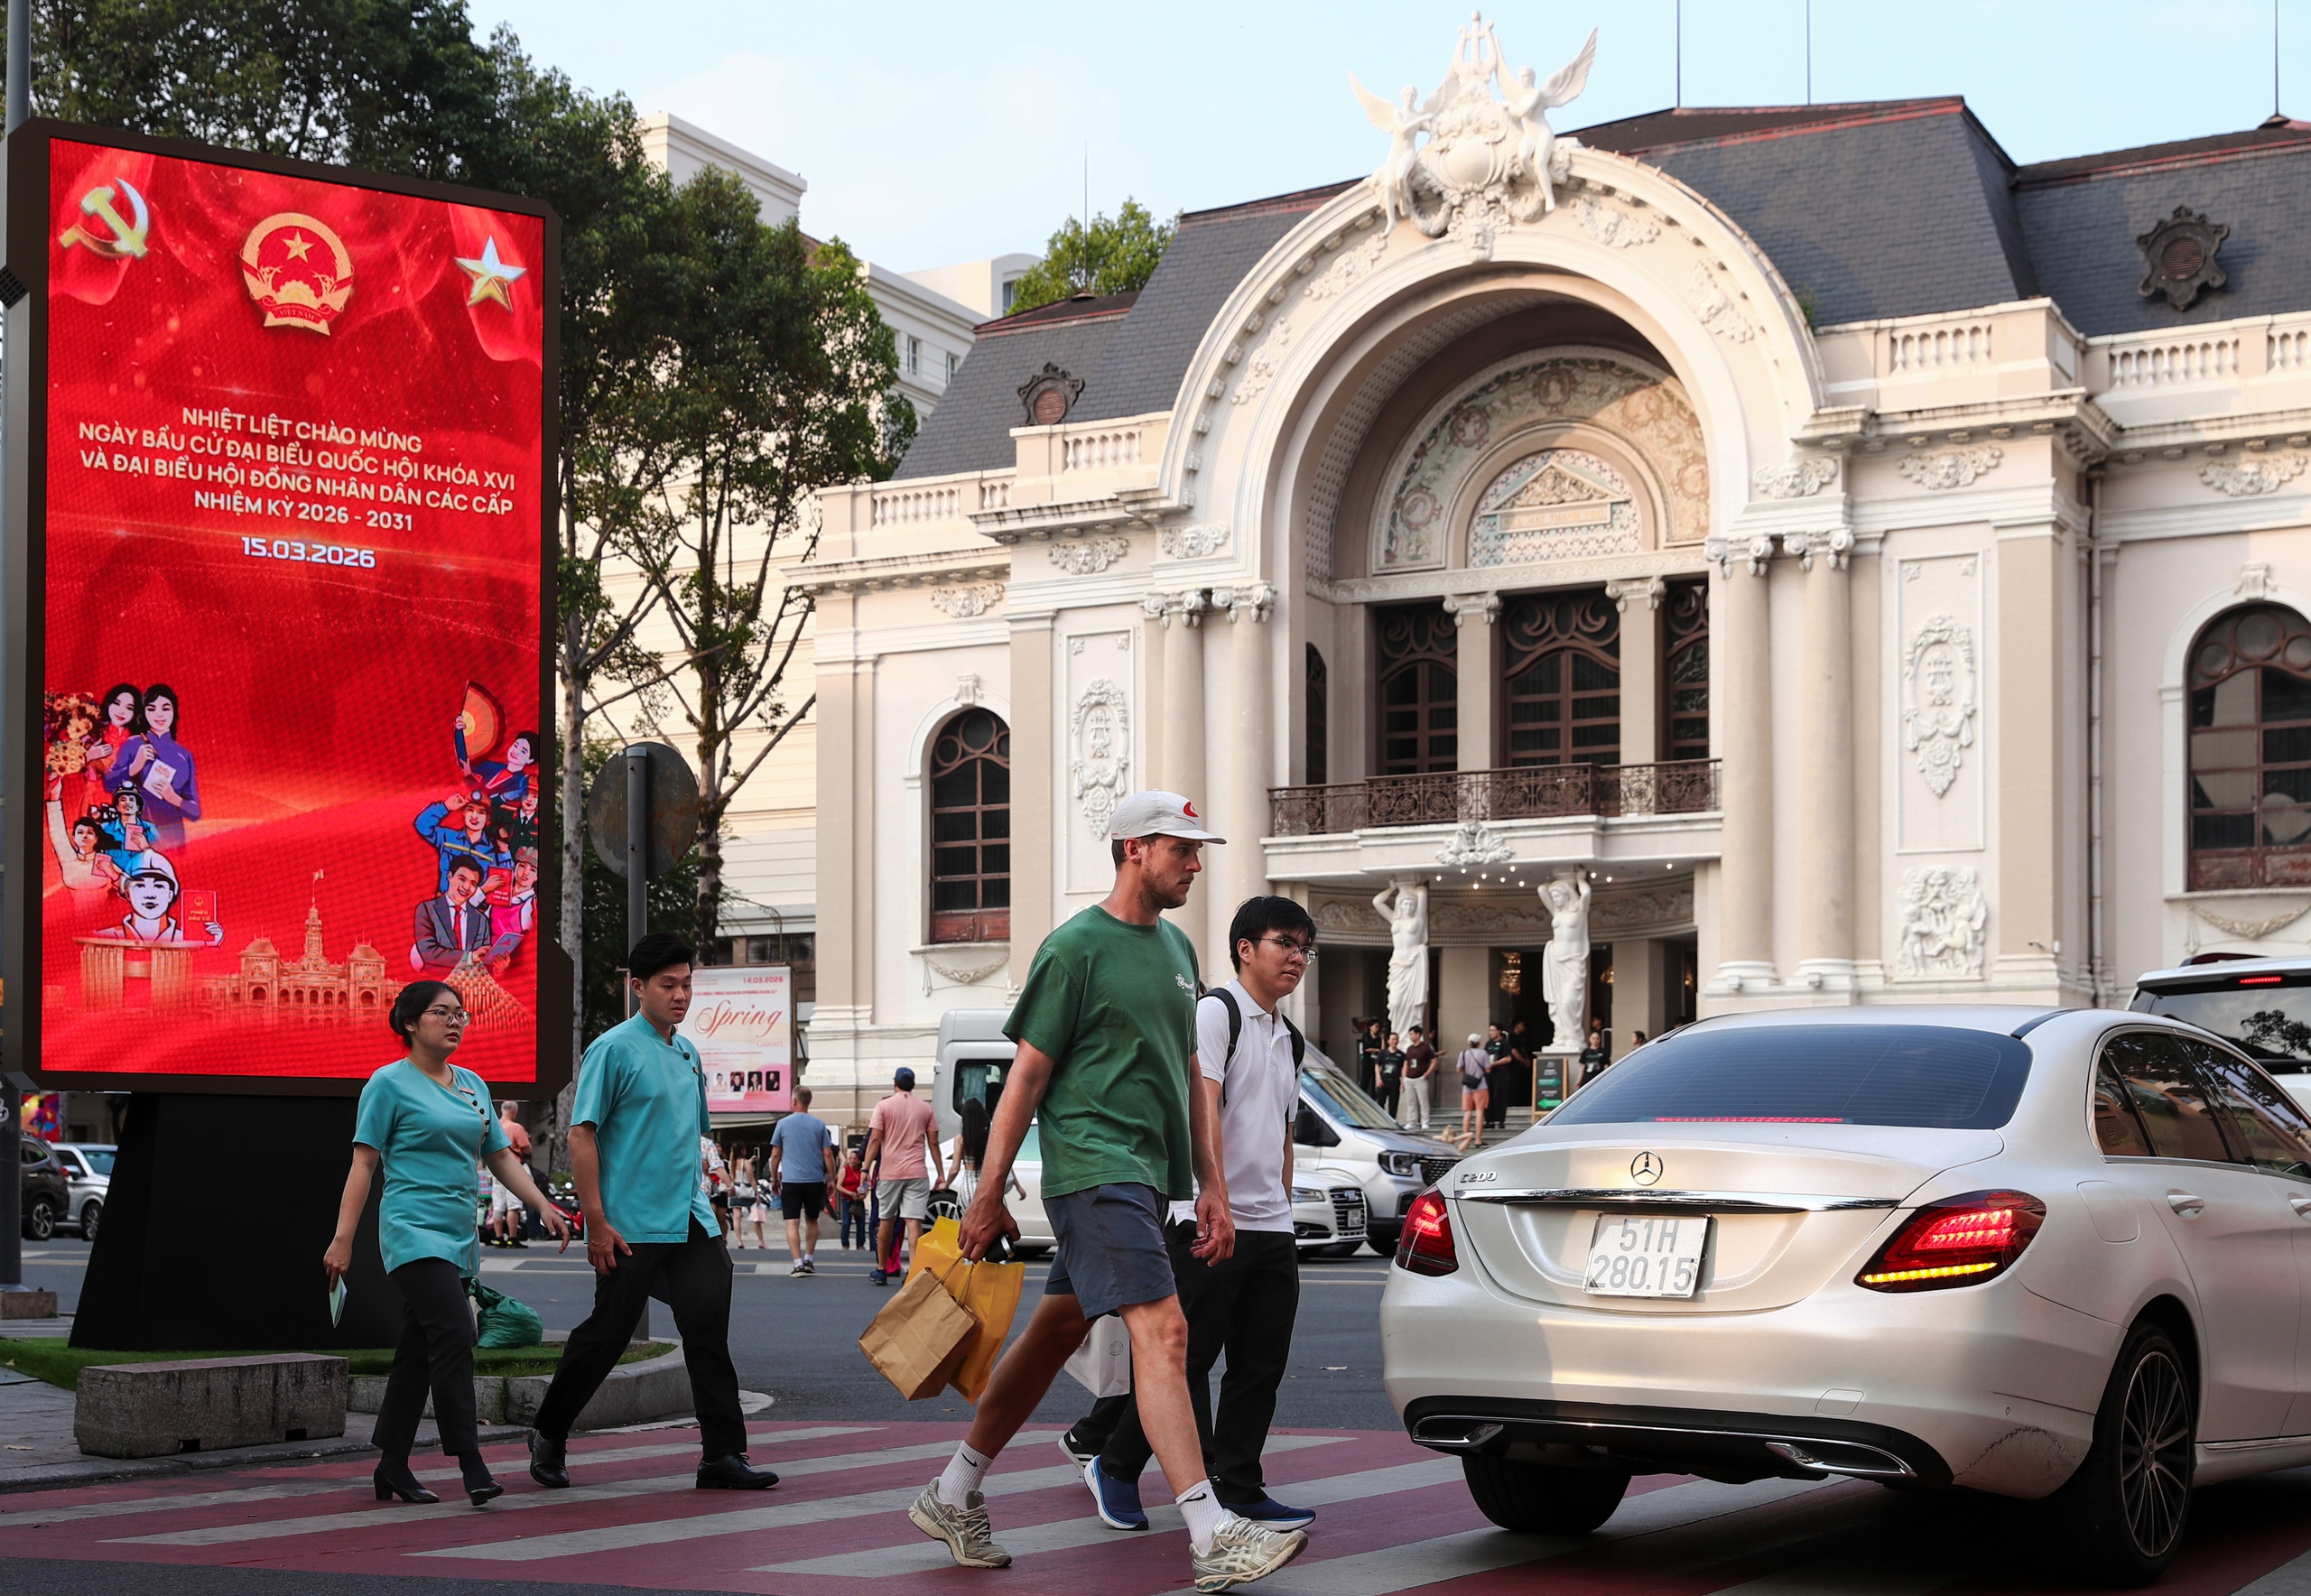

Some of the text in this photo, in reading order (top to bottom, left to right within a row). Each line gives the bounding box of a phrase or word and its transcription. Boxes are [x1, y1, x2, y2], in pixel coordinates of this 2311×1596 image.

[182, 406, 422, 453] NHIỆT LIỆT CHÀO MỪNG
[79, 420, 515, 491] NGÀY BẦU CỬ ĐẠI BIỂU QUỐC HỘI KHÓA XVI
[80, 445, 514, 515] VÀ ĐẠI BIỂU HỘI ĐỒNG NHÂN DÂN CÁC CẤP
[194, 490, 262, 516] NHIỆM
[267, 495, 294, 518] KỲ
[297, 502, 349, 524] 2026
[366, 510, 413, 531] 2031
[240, 536, 376, 569] 15.03.2026
[742, 976, 784, 984] 14.03.2026
[694, 999, 783, 1039] Spring
[1460, 1171, 1498, 1183] C200
[1620, 1219, 1680, 1253] 51H
[1591, 1255, 1694, 1291] 280.15
